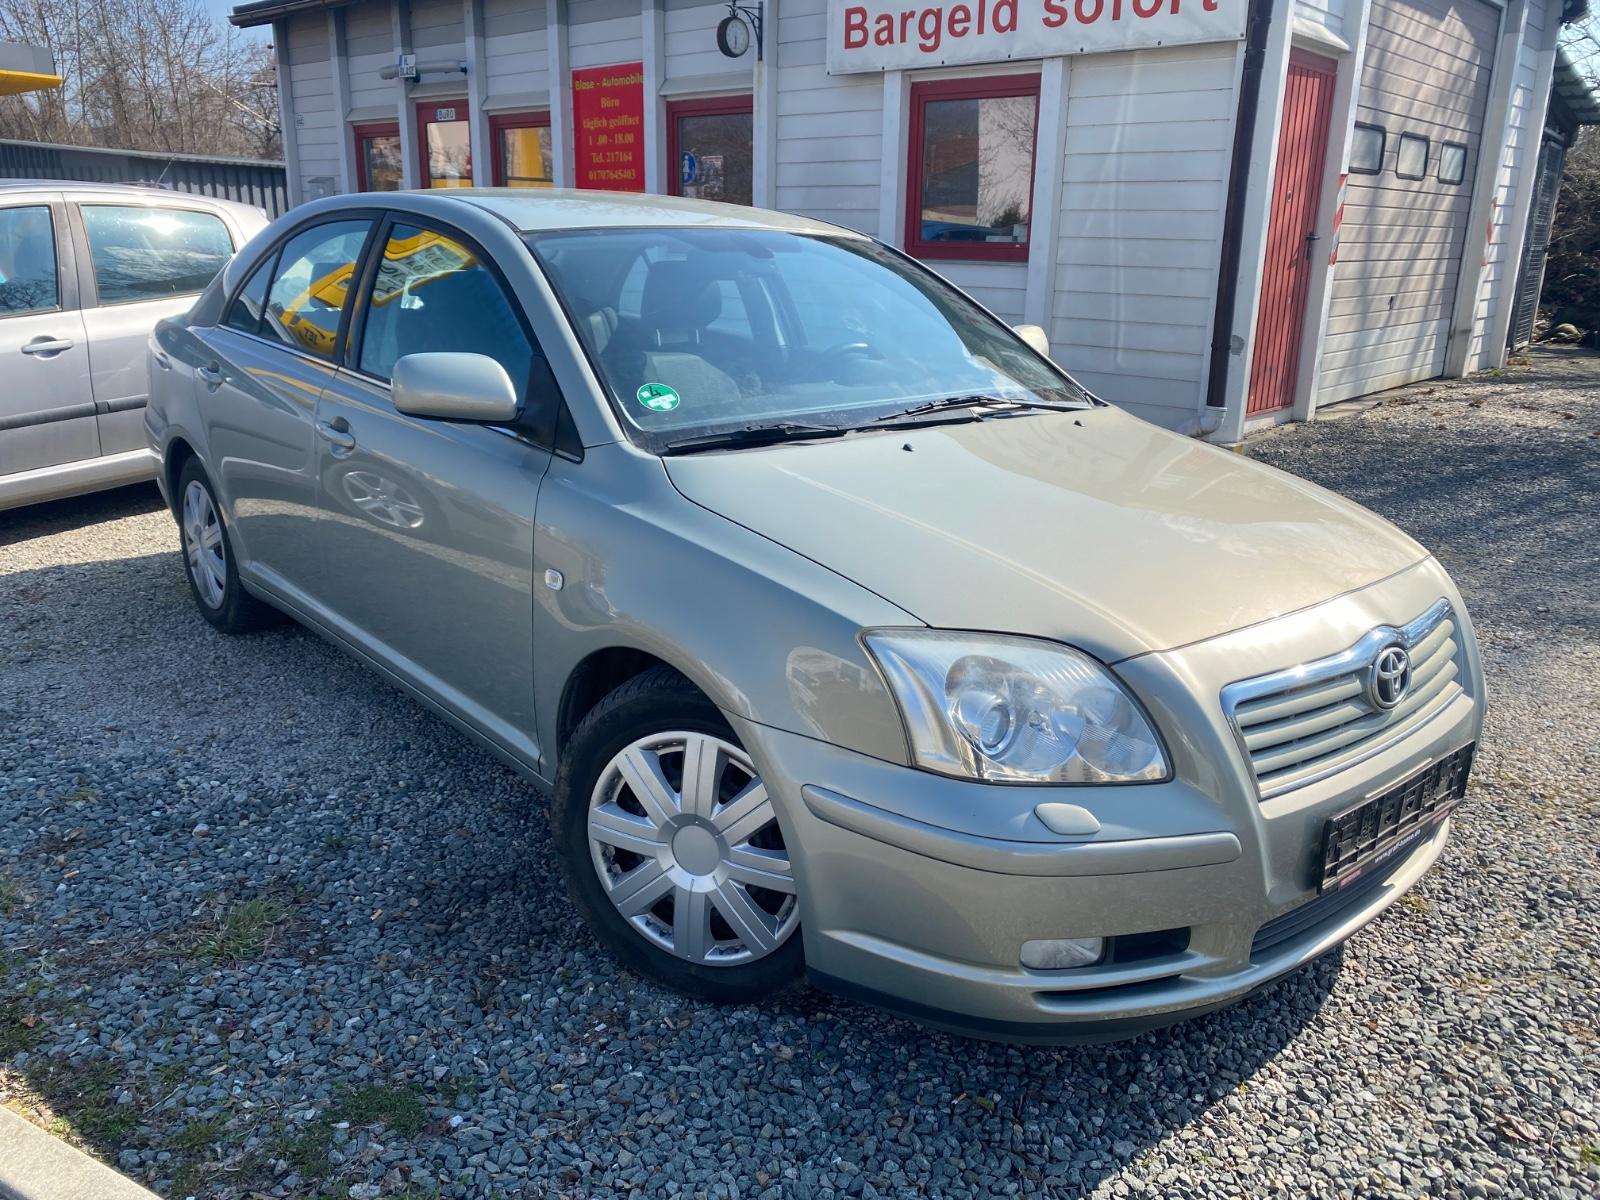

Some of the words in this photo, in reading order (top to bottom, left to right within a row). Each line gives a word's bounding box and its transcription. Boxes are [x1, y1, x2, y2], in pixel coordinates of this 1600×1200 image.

[844, 0, 1019, 53] Bargeld
[1042, 0, 1218, 28] soo
[600, 96, 620, 109] Büro
[583, 116, 608, 131] täglich
[608, 114, 640, 130] geöffnet
[649, 386, 662, 397] 4
